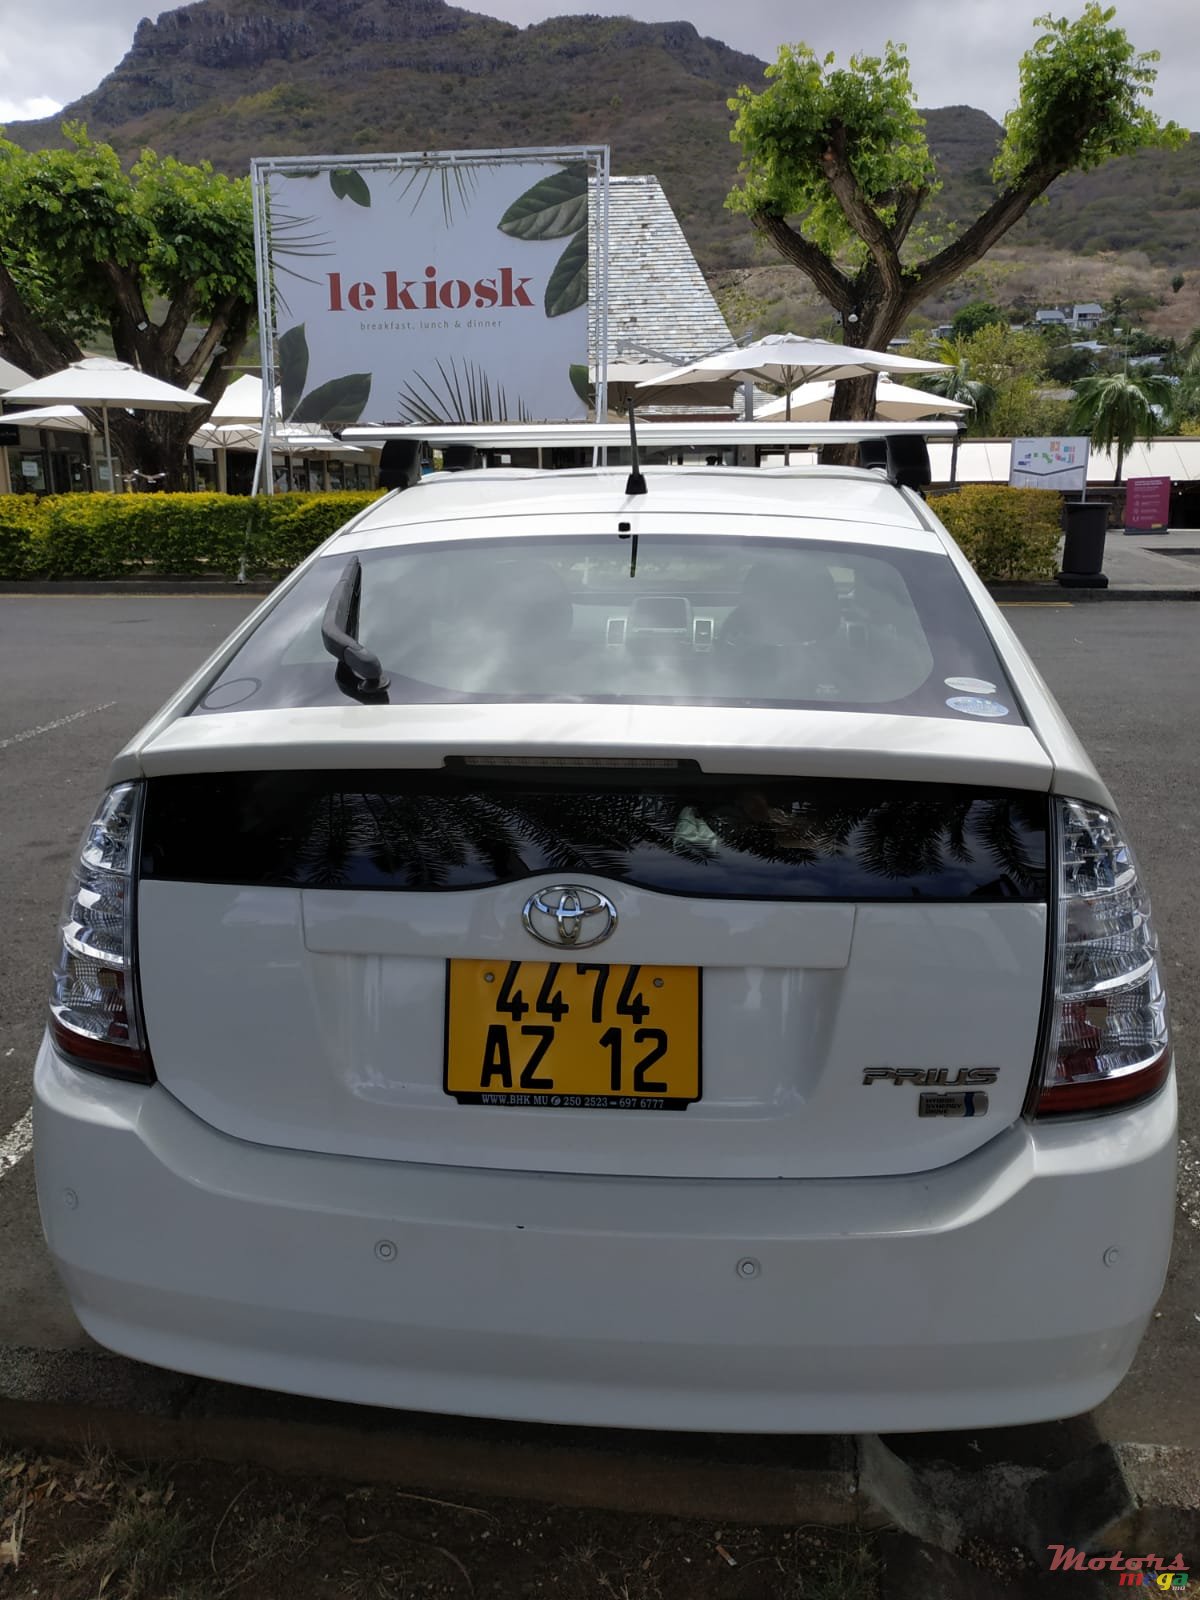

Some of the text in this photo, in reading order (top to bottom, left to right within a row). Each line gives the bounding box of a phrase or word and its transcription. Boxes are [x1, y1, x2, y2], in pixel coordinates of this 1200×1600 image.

[382, 265, 535, 310] kiosk
[420, 320, 449, 329] lunch
[454, 320, 462, 328] &
[467, 319, 502, 328] dinner
[496, 961, 650, 1024] 4474
[480, 1024, 668, 1092] AZ 12
[862, 1067, 1000, 1086] PRIUS
[563, 1097, 581, 1106] 250
[584, 1098, 608, 1107] 2523
[619, 1098, 637, 1108] 697
[640, 1099, 664, 1109] 6777
